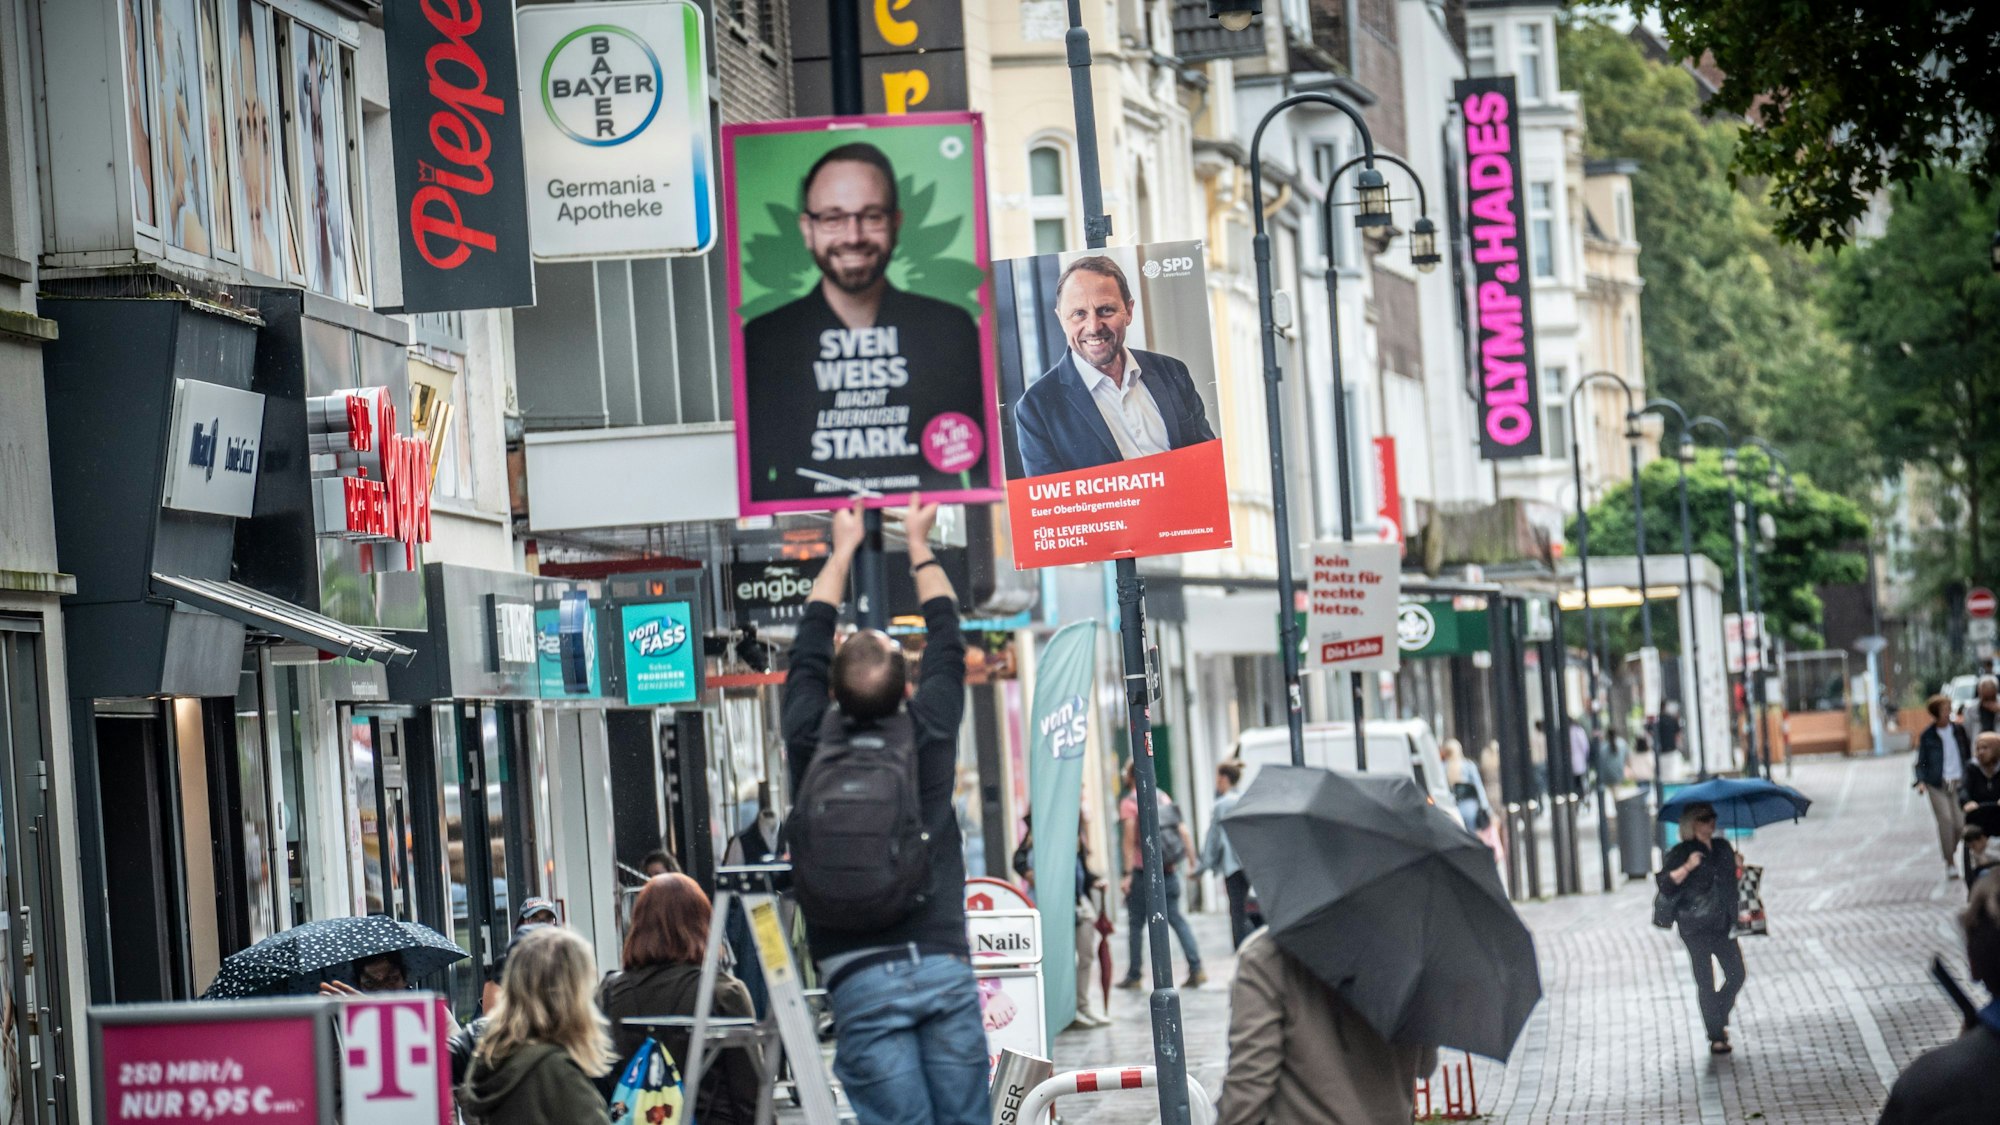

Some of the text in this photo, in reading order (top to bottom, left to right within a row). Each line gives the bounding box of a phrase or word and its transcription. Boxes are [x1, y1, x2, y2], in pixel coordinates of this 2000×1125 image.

[552, 74, 654, 98] BAYER
[590, 36, 616, 137] BAYER
[547, 174, 656, 199] Germania
[557, 199, 663, 225] Apotheke
[1162, 256, 1193, 272] SPD
[819, 326, 899, 360] SVEN
[813, 356, 909, 391] WEISS
[816, 405, 910, 428] LEVERKUSEN
[811, 426, 919, 461] STARK.
[1028, 471, 1165, 501] UWE RICHRATH
[1031, 498, 1141, 517] Euer Oberbürgermeister
[1033, 520, 1128, 540] FÜR LEVERKUSEN.
[1158, 527, 1214, 538] SPD-LEVERKUSEN.DE
[1034, 536, 1088, 551] FÜR DICH.
[1314, 555, 1349, 567] Kein
[737, 575, 818, 602] engbe
[1314, 570, 1382, 584] Platz für
[1313, 587, 1365, 599] rechte
[1313, 603, 1364, 615] Hetze.
[628, 620, 659, 643] vom
[640, 624, 686, 656] FASS
[1326, 641, 1379, 659] Die Linke
[637, 670, 685, 681] PROBIEREN
[1040, 702, 1074, 736] vom
[1053, 713, 1089, 759] FAS
[977, 933, 1031, 952] Nails
[119, 1056, 244, 1086] 250 MBit/s
[120, 1089, 184, 1119] NUR
[999, 1084, 1025, 1125] SER
